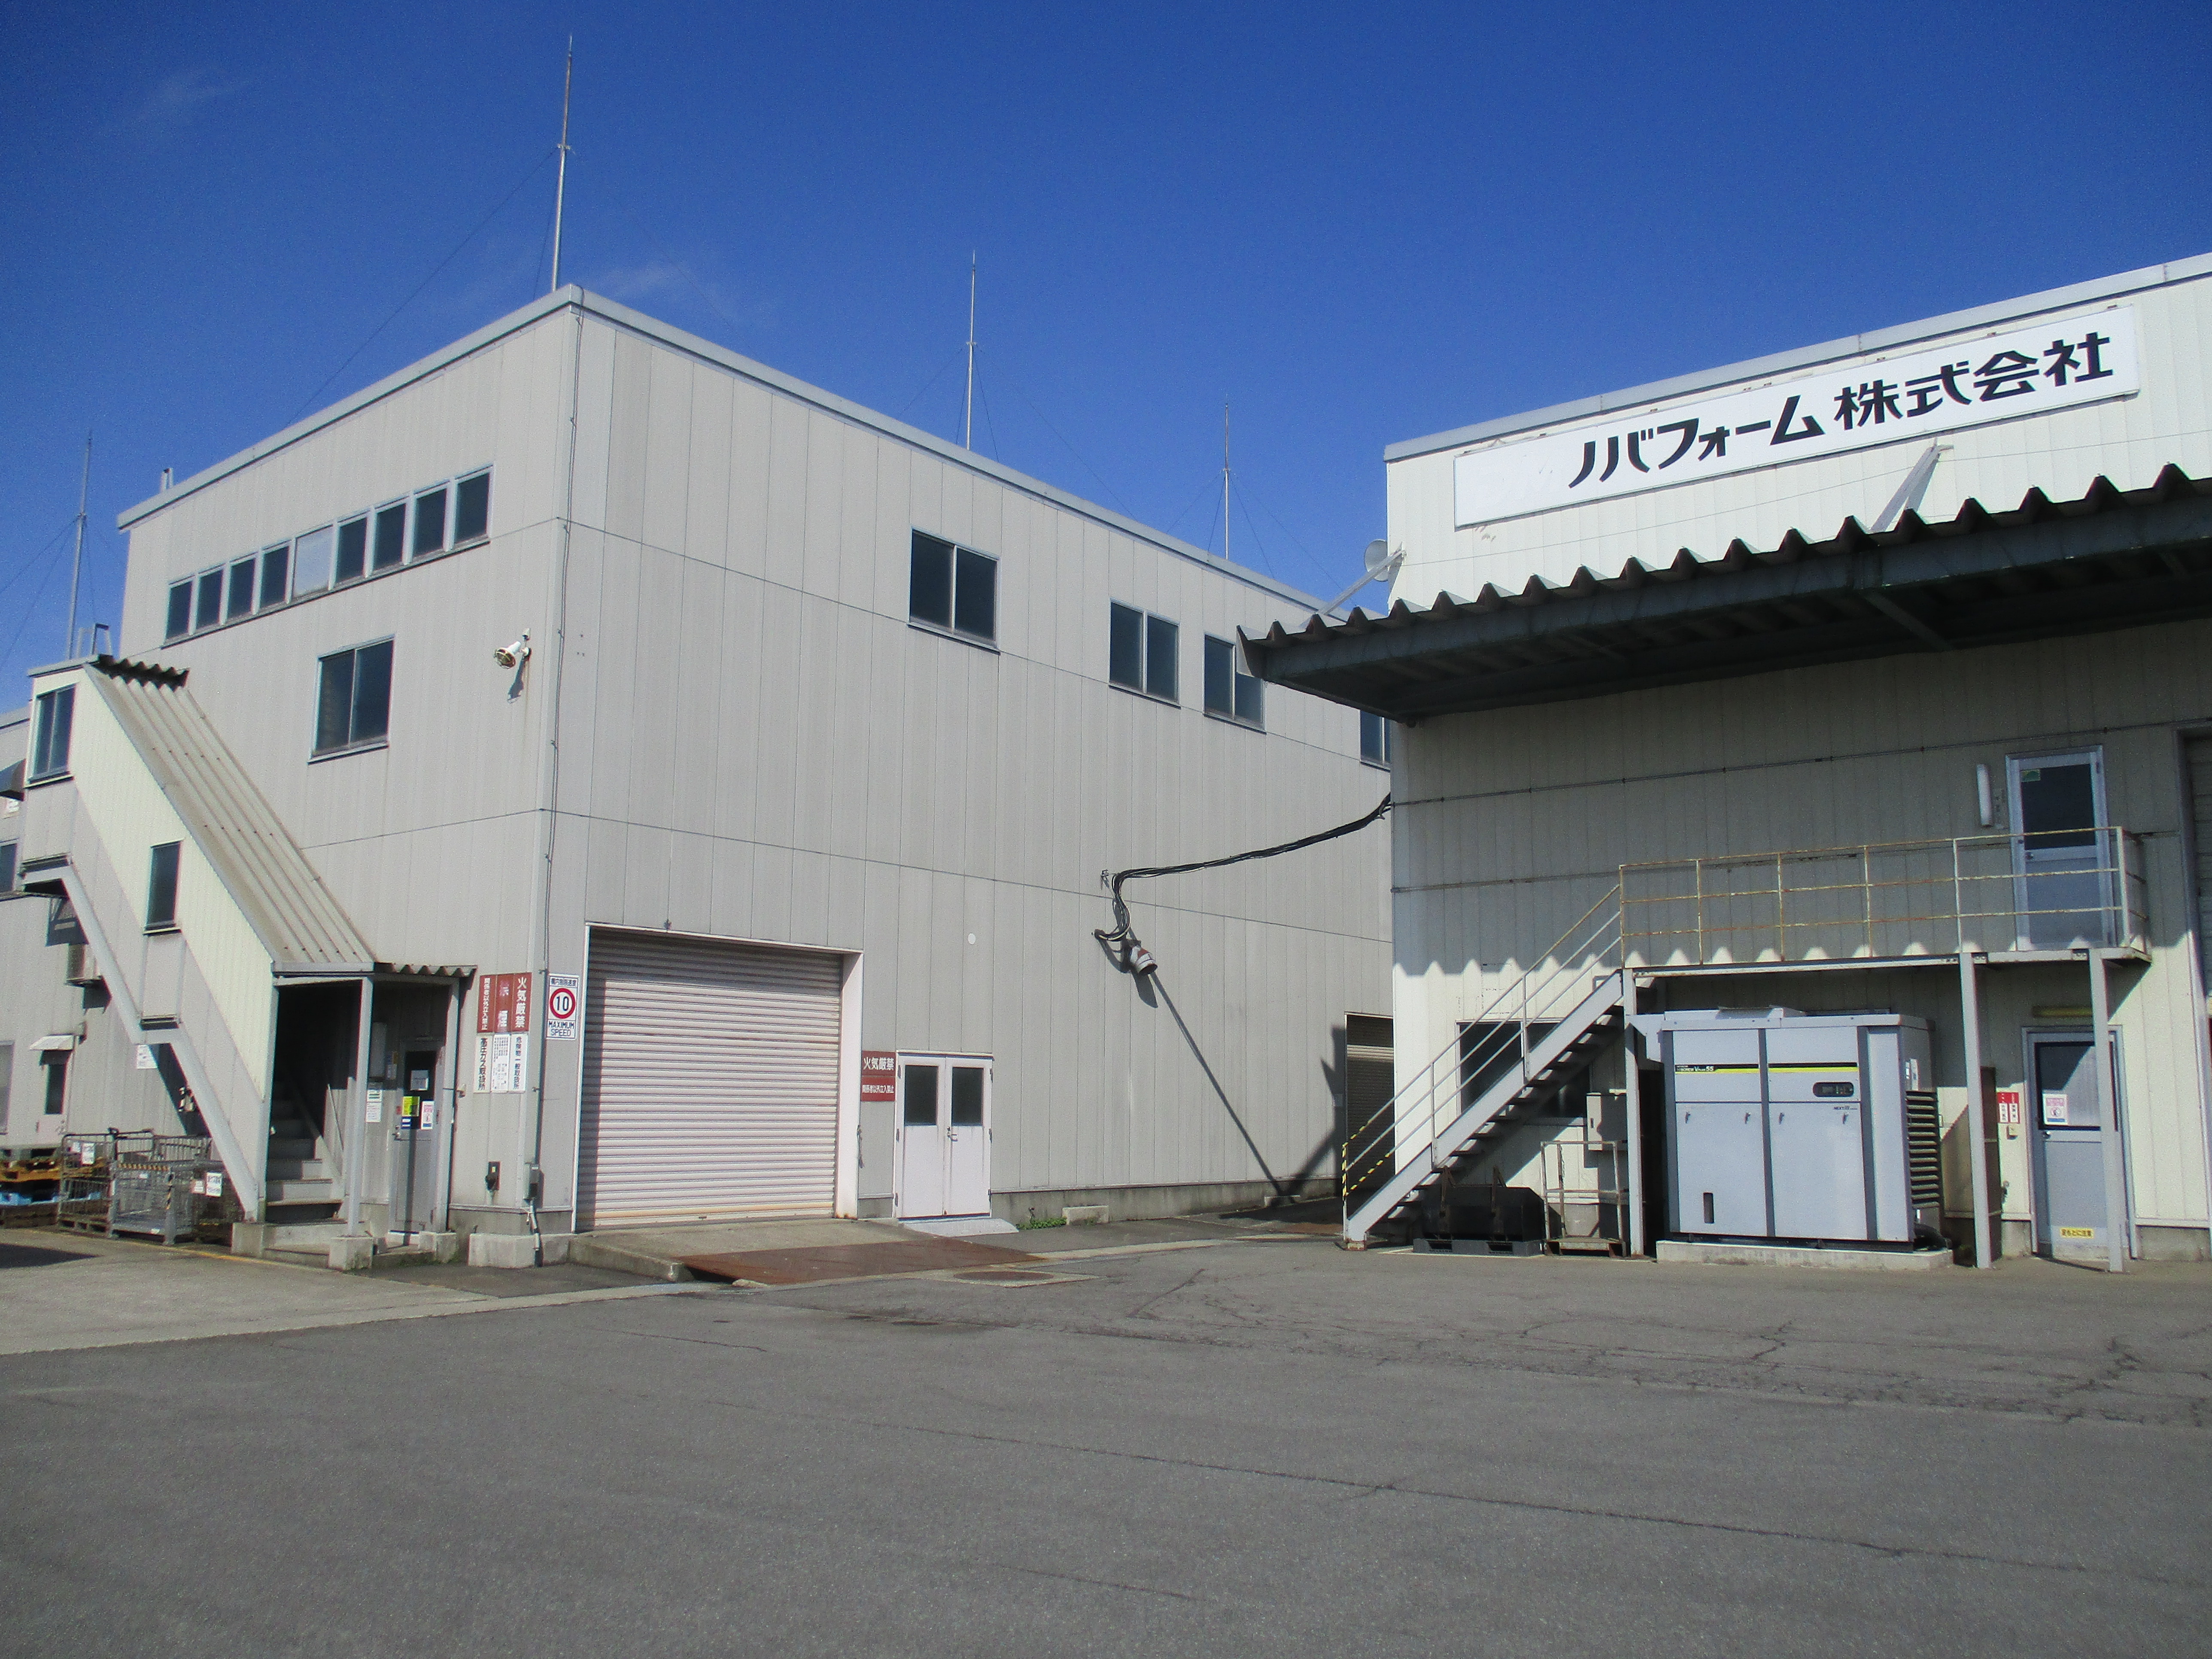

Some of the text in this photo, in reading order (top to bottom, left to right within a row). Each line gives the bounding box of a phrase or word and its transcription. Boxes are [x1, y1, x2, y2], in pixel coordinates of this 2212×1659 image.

[515, 977, 527, 1028] 火気厳禁
[557, 996, 569, 1011] 10
[548, 1021, 574, 1029] MAXIMUM
[863, 1056, 894, 1071] 火気厳禁
